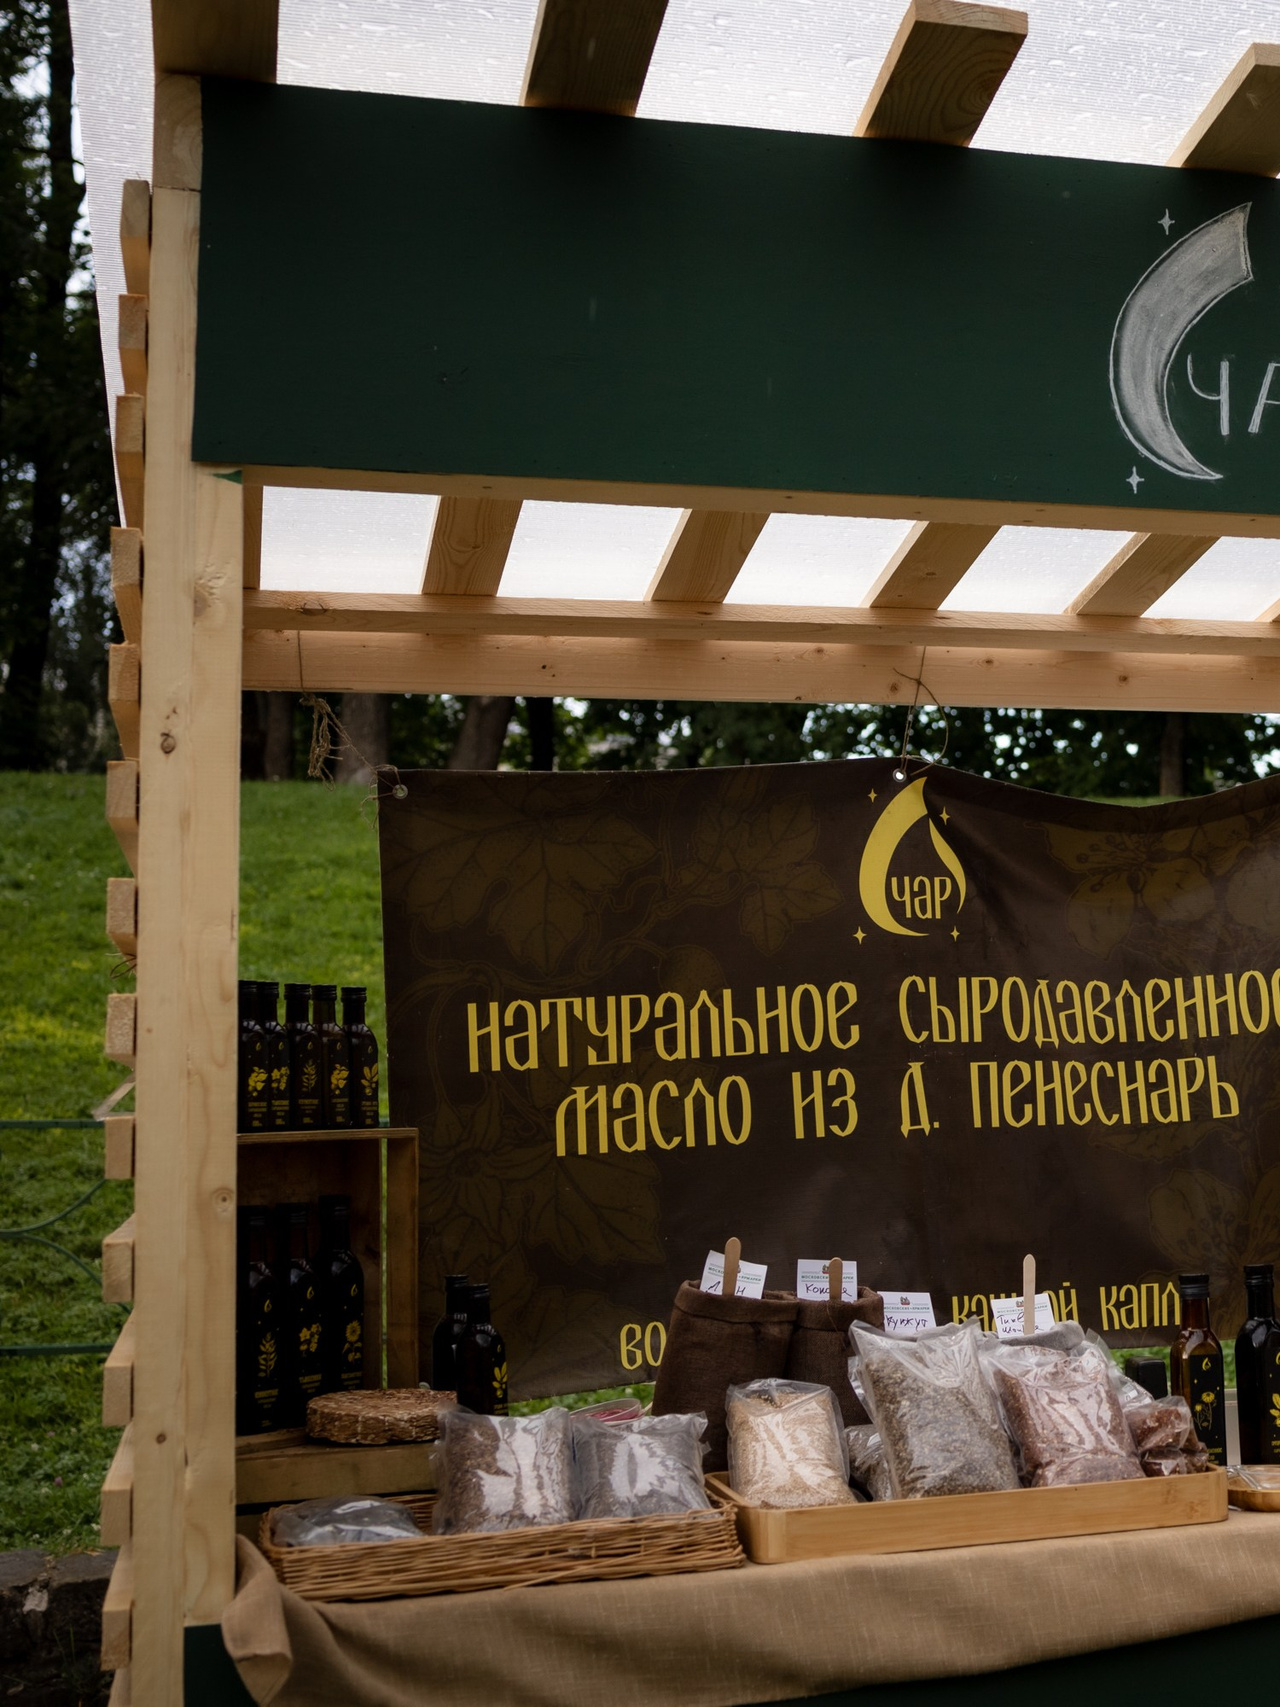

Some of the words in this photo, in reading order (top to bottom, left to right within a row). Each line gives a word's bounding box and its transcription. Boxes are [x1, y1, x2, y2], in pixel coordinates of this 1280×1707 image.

[891, 875, 952, 919] ЧАР
[467, 980, 860, 1073] НАТУРАЛЬНОЕ
[555, 1074, 754, 1157] МАСЛО
[793, 1067, 859, 1140] ИЗ
[971, 1055, 1240, 1130] ПЕНЕСНАРЬ
[1100, 1281, 1181, 1331] КАПЛ
